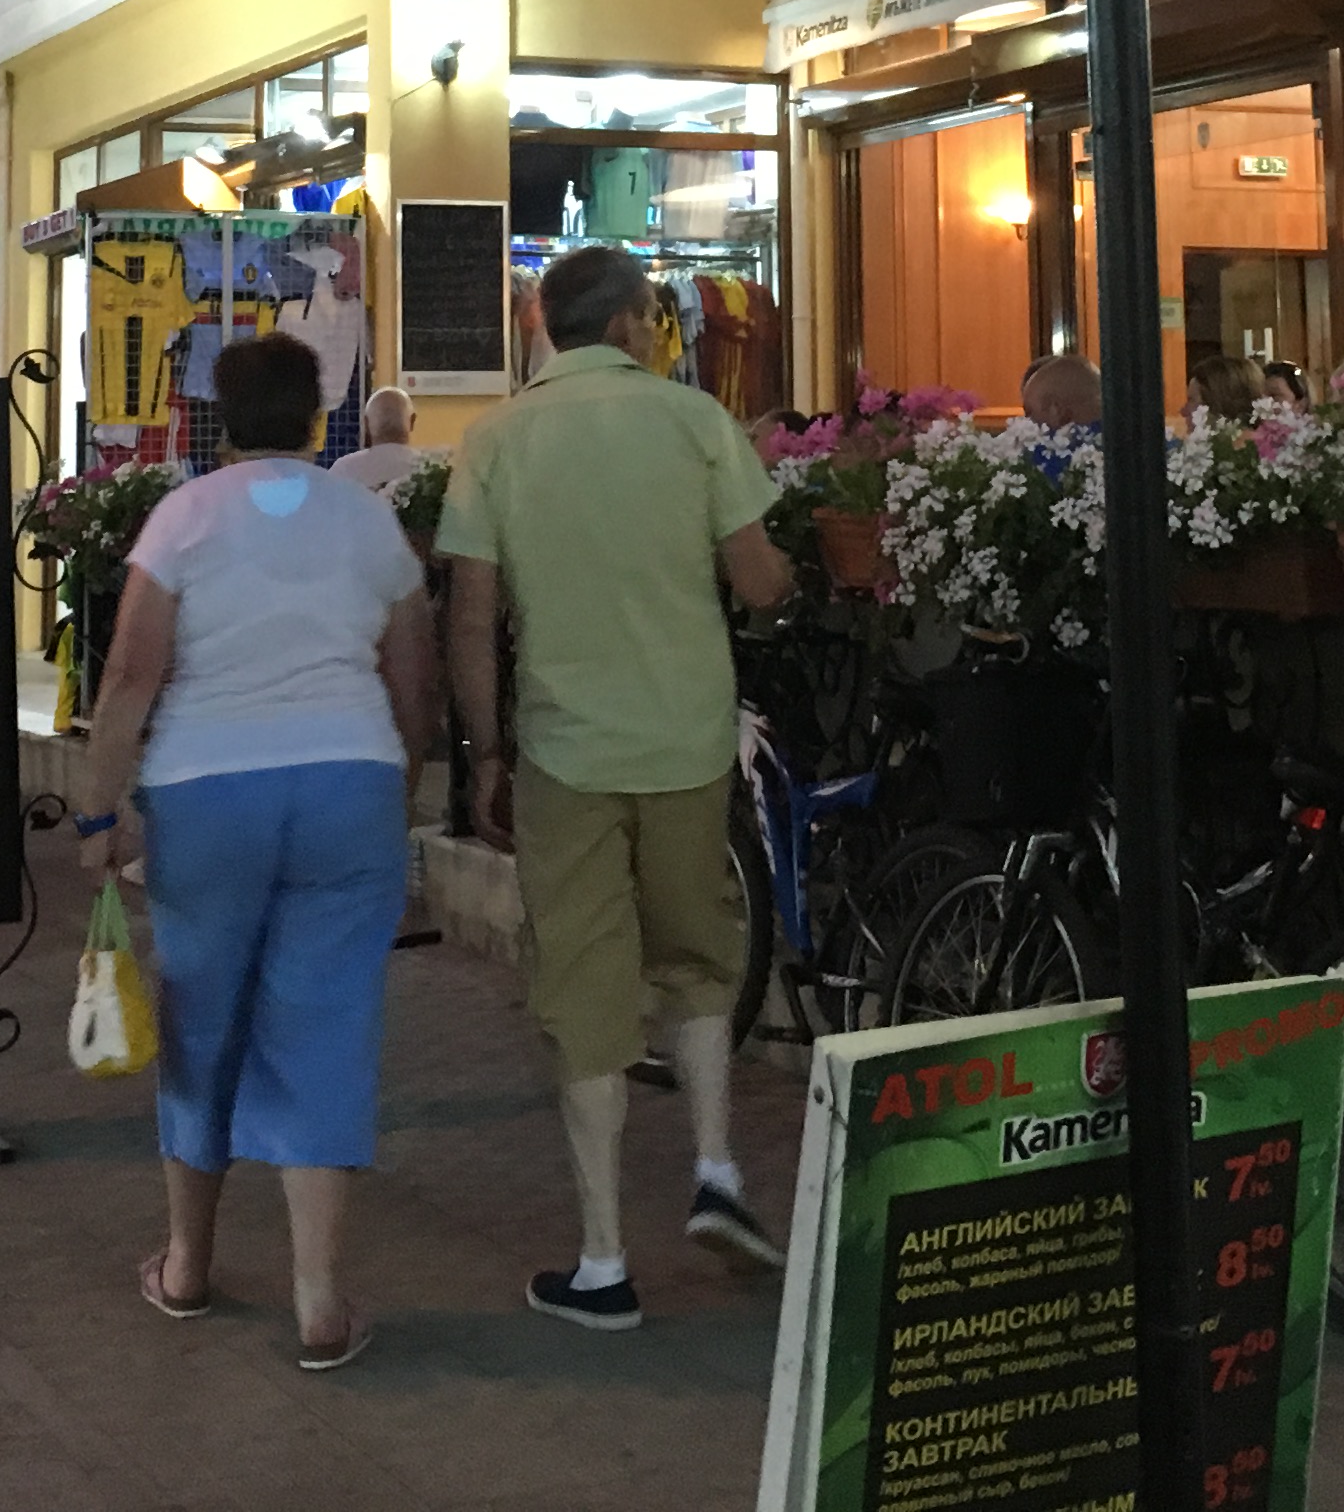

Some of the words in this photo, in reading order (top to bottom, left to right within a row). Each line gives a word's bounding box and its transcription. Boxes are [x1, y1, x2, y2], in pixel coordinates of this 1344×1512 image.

[794, 14, 849, 47] Kamenitza
[871, 1052, 1034, 1124] ATOL
[900, 1195, 1085, 1256] АНГЛИЙСКИЙ
[893, 1291, 1081, 1351] ИРЛАНДСКИЙ
[884, 1375, 1138, 1445] КОНТИНЕНТАЛЬНЫ
[882, 1430, 1009, 1473] ЗАВТРАК
